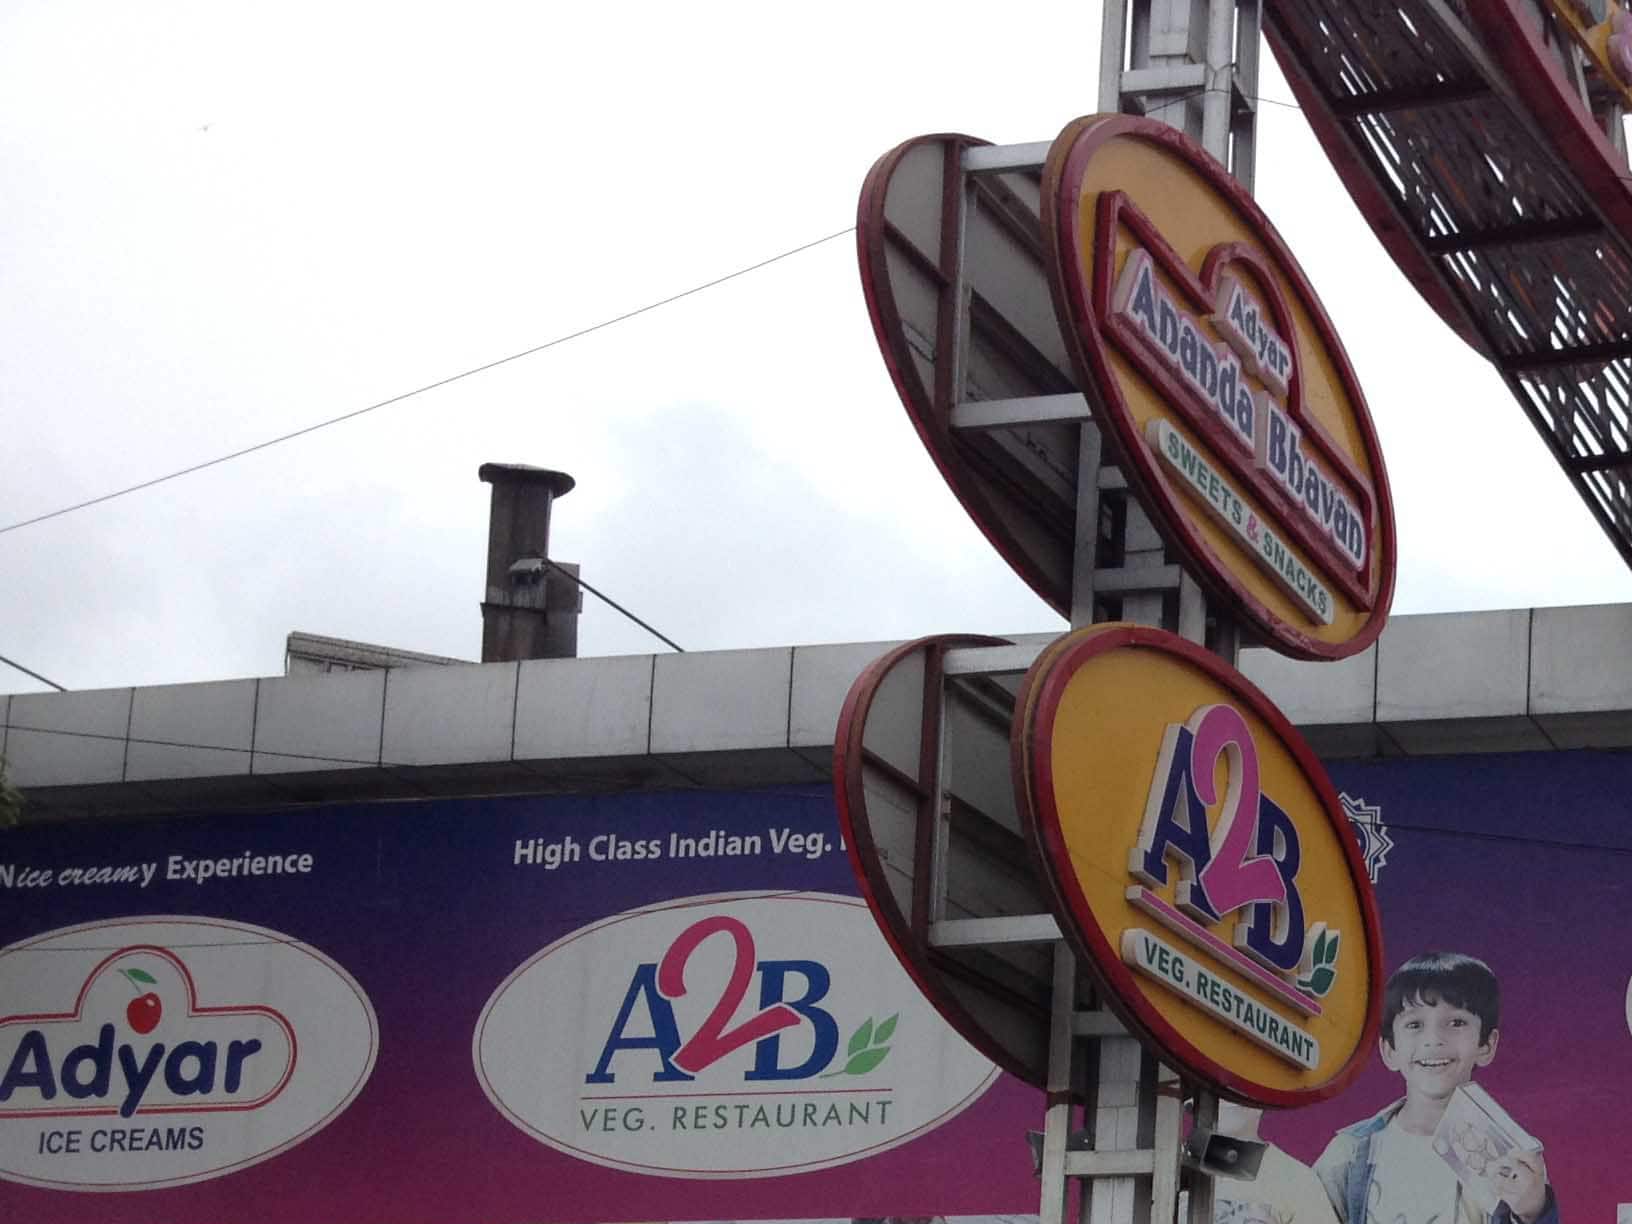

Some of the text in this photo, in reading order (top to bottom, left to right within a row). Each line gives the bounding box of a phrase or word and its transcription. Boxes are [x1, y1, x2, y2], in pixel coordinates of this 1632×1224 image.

[1230, 288, 1289, 378] Adyar
[1131, 265, 1364, 562] Ananda Bhavan
[1168, 431, 1329, 617] SWEETS & SNACKS
[57, 862, 157, 888] creamy
[166, 850, 314, 884] Experience
[513, 837, 581, 870] High
[587, 834, 662, 861] Class
[668, 829, 763, 858] Indian
[768, 827, 832, 859] Veg.
[1140, 702, 1305, 971] A2B
[584, 915, 841, 1084] A2B
[1143, 936, 1314, 1062] VEG. RESTAURANT
[0, 1022, 262, 1119] Adyar
[580, 1100, 893, 1132] VEG. RESTAURANT
[38, 1126, 205, 1155] ICE CREAMS
